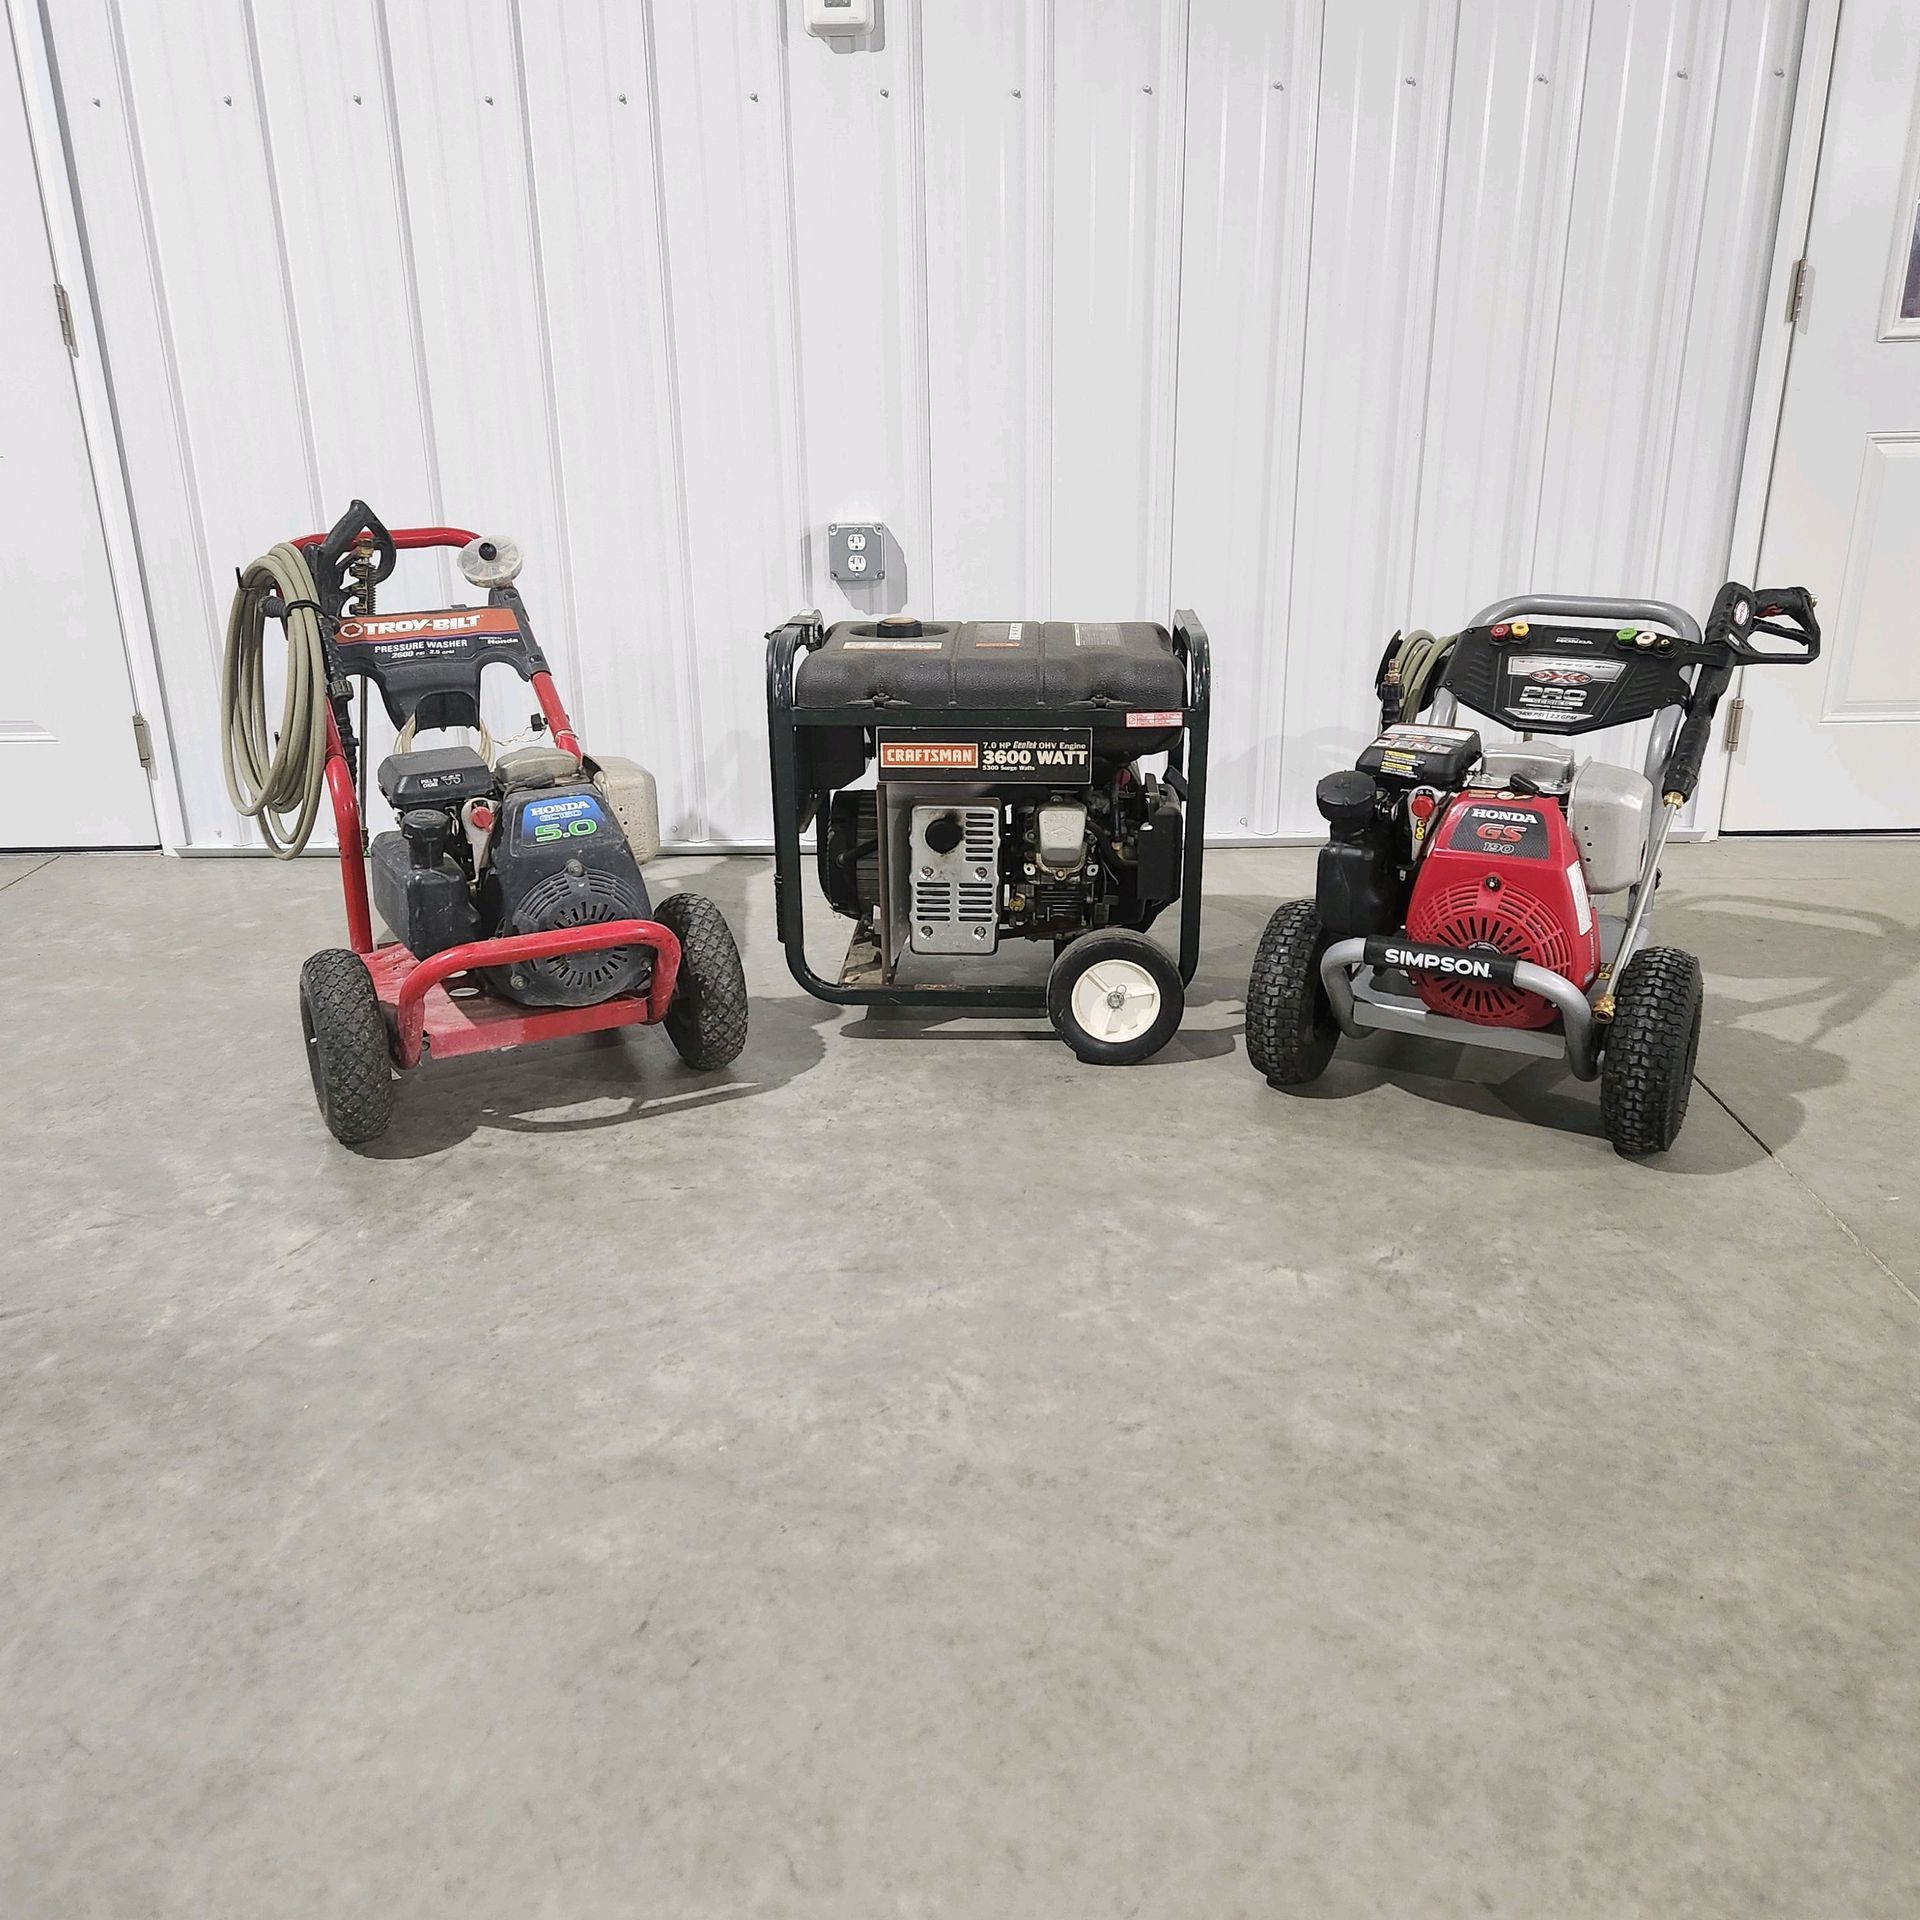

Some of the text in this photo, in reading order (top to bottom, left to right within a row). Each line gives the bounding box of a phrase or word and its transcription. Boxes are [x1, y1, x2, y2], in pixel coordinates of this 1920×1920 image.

[364, 614, 481, 635] TROY-BILT
[374, 639, 468, 654] PRESSURE WASHER
[487, 637, 519, 645] Honda
[391, 650, 414, 659] 2600
[1521, 686, 1588, 702] PRO
[982, 741, 997, 749] 7.0
[999, 741, 1012, 749] HP
[1059, 742, 1087, 751] Engine
[886, 748, 973, 763] CRAFTSMAN
[982, 749, 1089, 765] 3600 WATT
[1000, 764, 1018, 772] Surge
[530, 800, 591, 816] HONDA
[1471, 808, 1539, 824] HONDA
[534, 818, 598, 842] 5.0
[1476, 822, 1528, 843] GS
[1483, 841, 1515, 854] 190
[1384, 948, 1491, 978] SIMPSON
